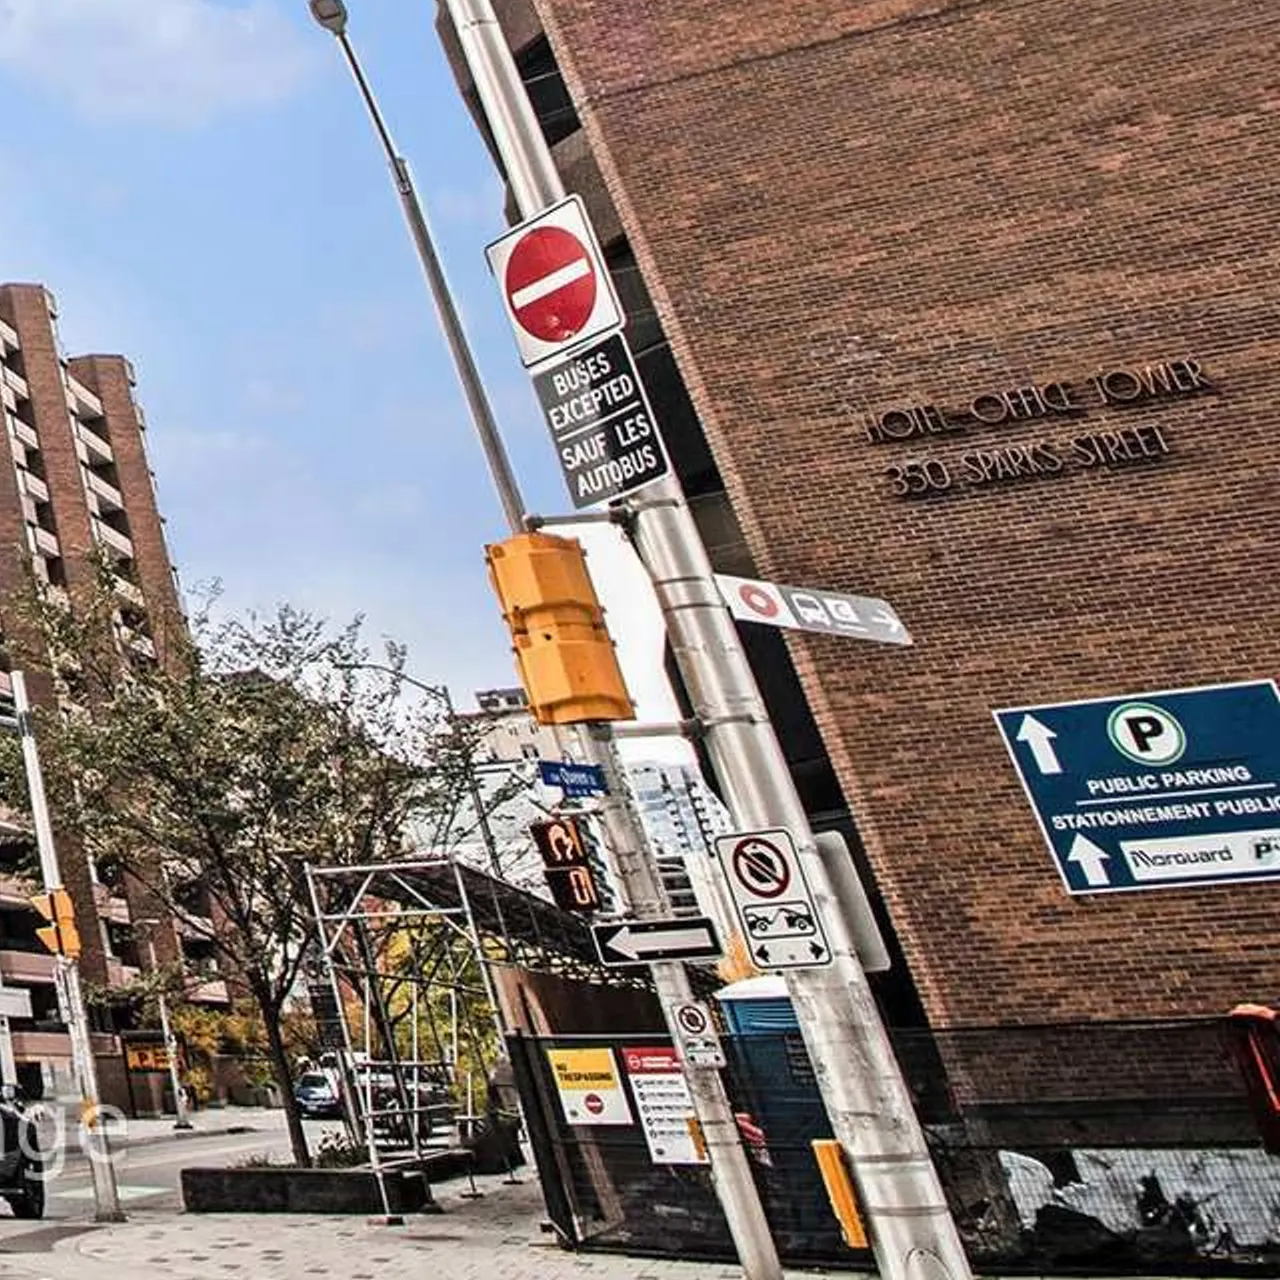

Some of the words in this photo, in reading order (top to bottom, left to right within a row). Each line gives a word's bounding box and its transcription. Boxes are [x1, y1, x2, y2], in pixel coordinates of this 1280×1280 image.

[552, 352, 610, 396] BUSES
[548, 374, 633, 429] EXCEPTED
[864, 406, 956, 443] HOTEL
[1090, 359, 1213, 404] TOWER
[562, 432, 606, 469] SAUF
[614, 413, 650, 447] LES
[889, 461, 952, 495] 350
[960, 443, 1062, 483] SPARKS
[1070, 425, 1170, 466] STREET
[577, 445, 657, 497] AUTOBUS
[1123, 716, 1164, 752] P
[1086, 774, 1159, 796] PUBLIC
[1163, 765, 1252, 786] PARKING
[1051, 803, 1211, 830] STATIONNEMENT
[1129, 845, 1234, 869] Morguard
